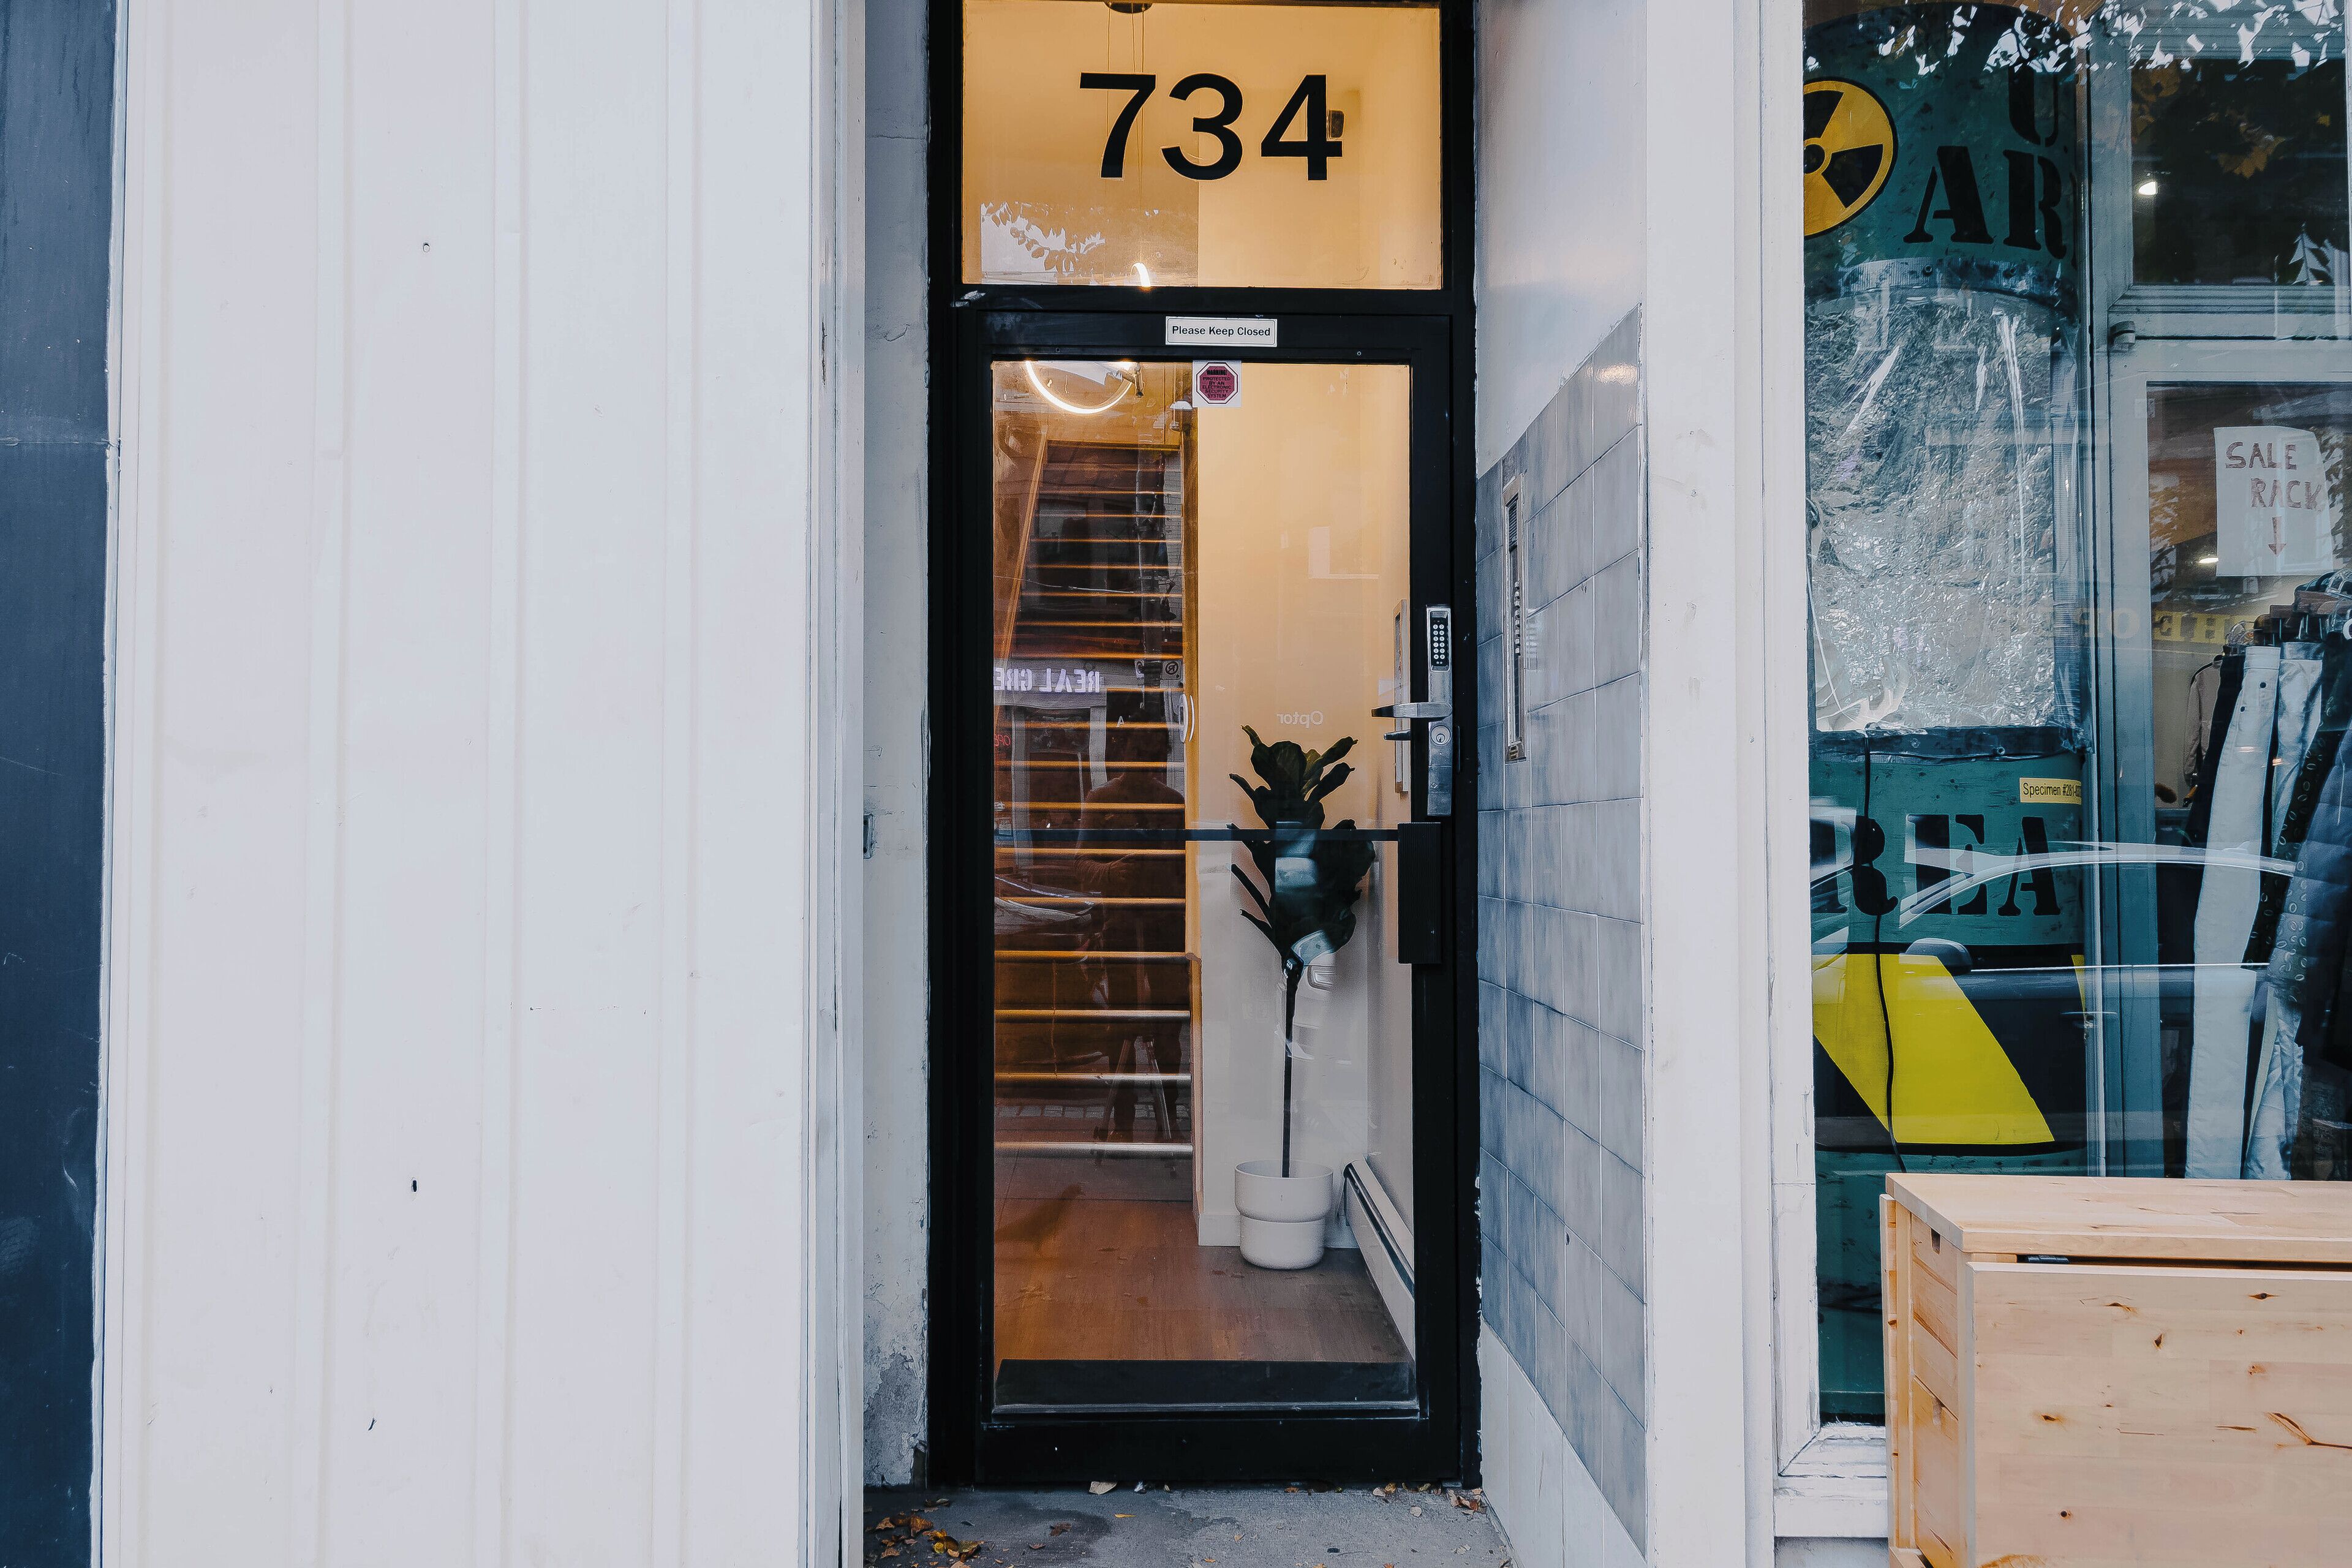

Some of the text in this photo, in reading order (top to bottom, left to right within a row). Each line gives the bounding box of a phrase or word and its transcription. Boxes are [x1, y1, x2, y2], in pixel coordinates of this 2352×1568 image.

[1080, 72, 1343, 181] 734
[1903, 146, 2076, 270] AR
[1172, 326, 1270, 337] Please Keep Closed
[2225, 441, 2297, 470] SALE
[2250, 478, 2322, 512] RACK
[2023, 783, 2061, 798] Specimen
[1810, 814, 2062, 916] REA
